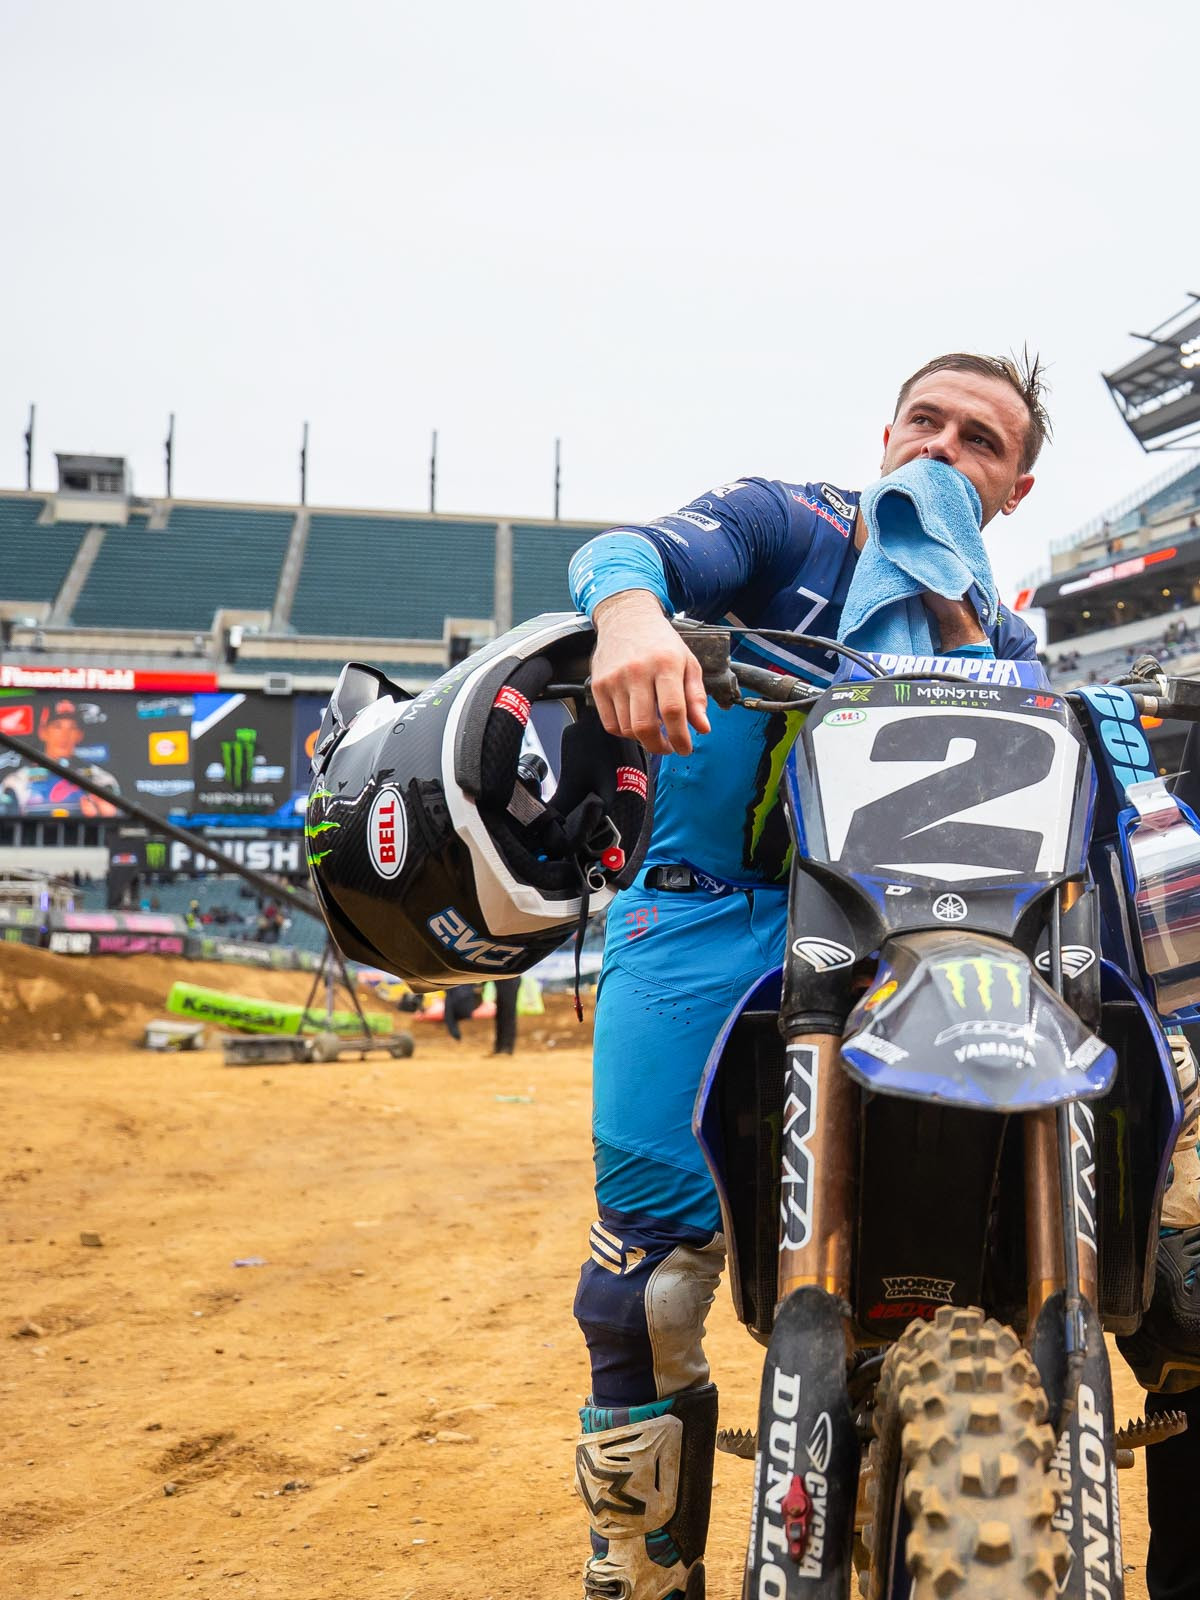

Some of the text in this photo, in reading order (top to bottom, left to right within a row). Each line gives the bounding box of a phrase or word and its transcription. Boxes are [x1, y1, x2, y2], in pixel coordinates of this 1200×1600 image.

[89, 669, 135, 690] Field
[878, 652, 1018, 687] PROTAPER
[501, 691, 520, 705] PULL
[917, 686, 1001, 701] MONSTER
[930, 699, 989, 708] ENERGY
[623, 773, 639, 781] PULL
[840, 714, 1056, 873] 2
[379, 800, 397, 863] BELL
[182, 997, 286, 1029] Kawasaki
[954, 1041, 1037, 1068] YAMAHA
[885, 1278, 953, 1292] WORKS
[798, 1470, 829, 1579] CYCRA
